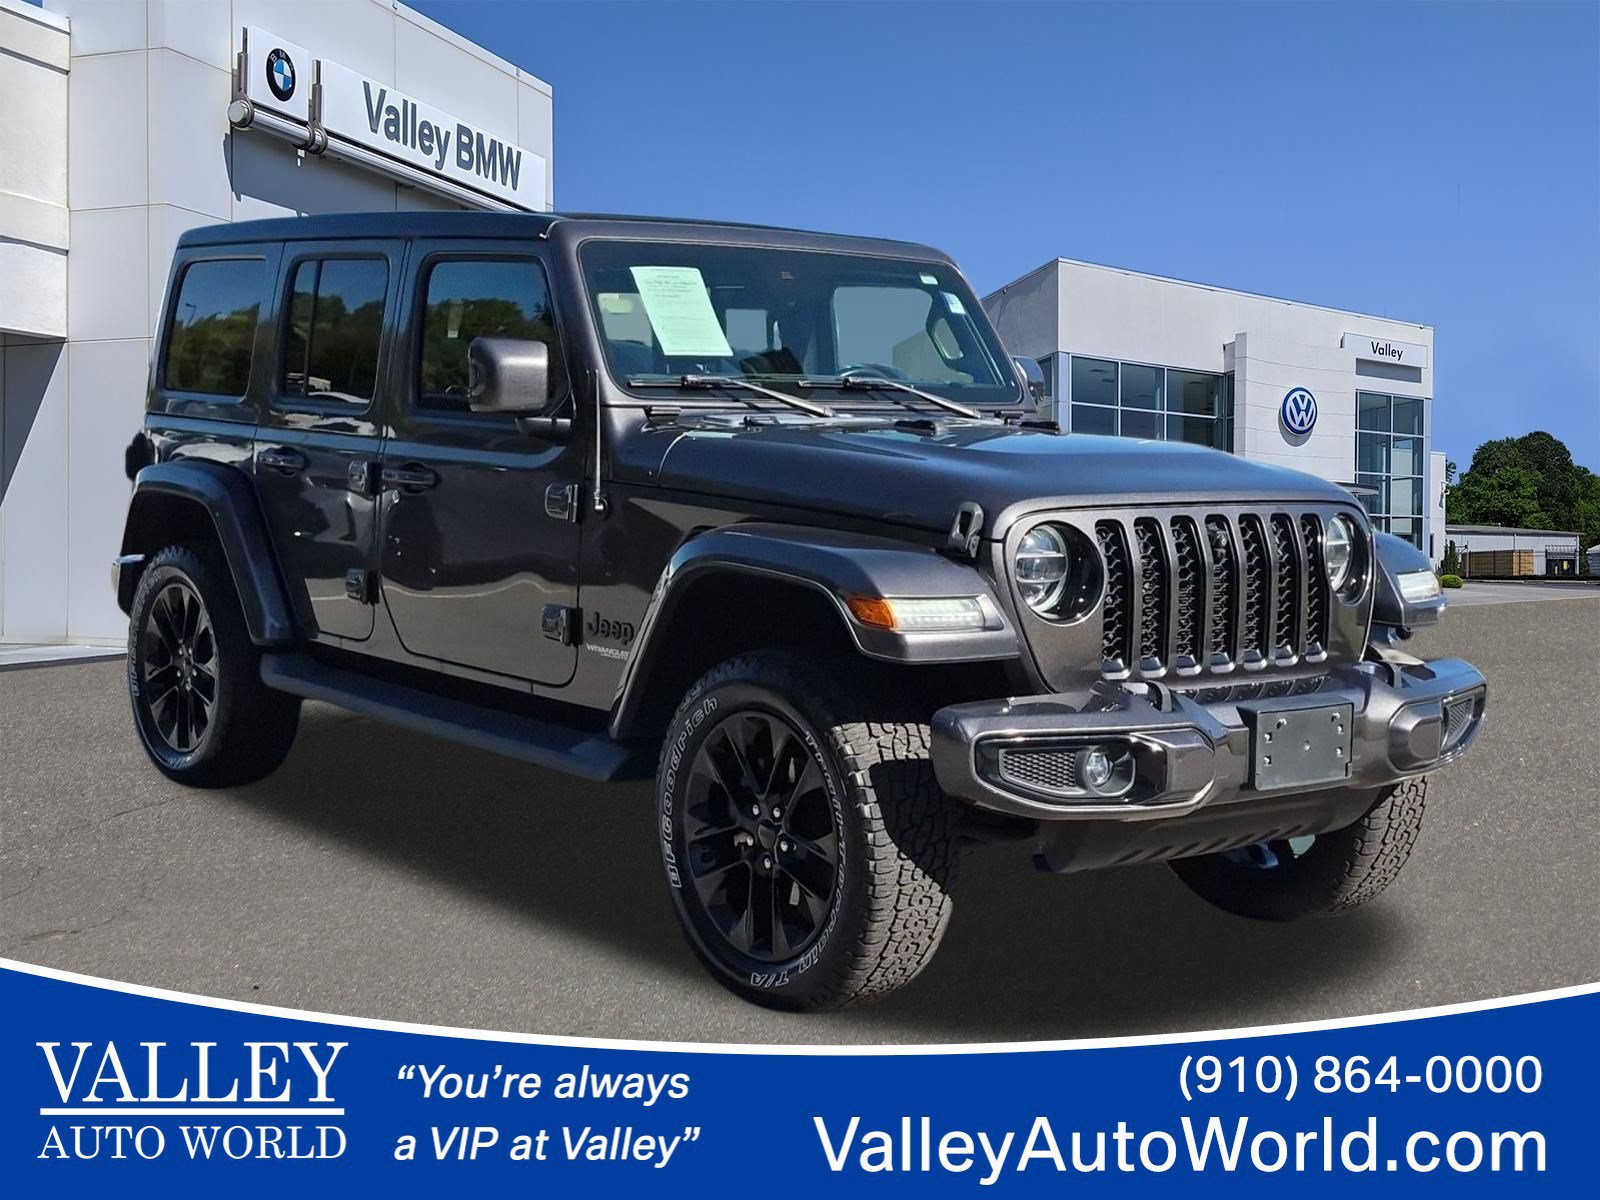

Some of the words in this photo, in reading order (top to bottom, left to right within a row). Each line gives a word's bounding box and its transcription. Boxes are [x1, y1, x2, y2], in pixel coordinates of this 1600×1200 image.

[362, 80, 450, 171] Valley
[456, 122, 522, 191] BMW
[1371, 341, 1403, 360] Valley
[586, 611, 635, 645] Jeep
[750, 971, 790, 989] T/A
